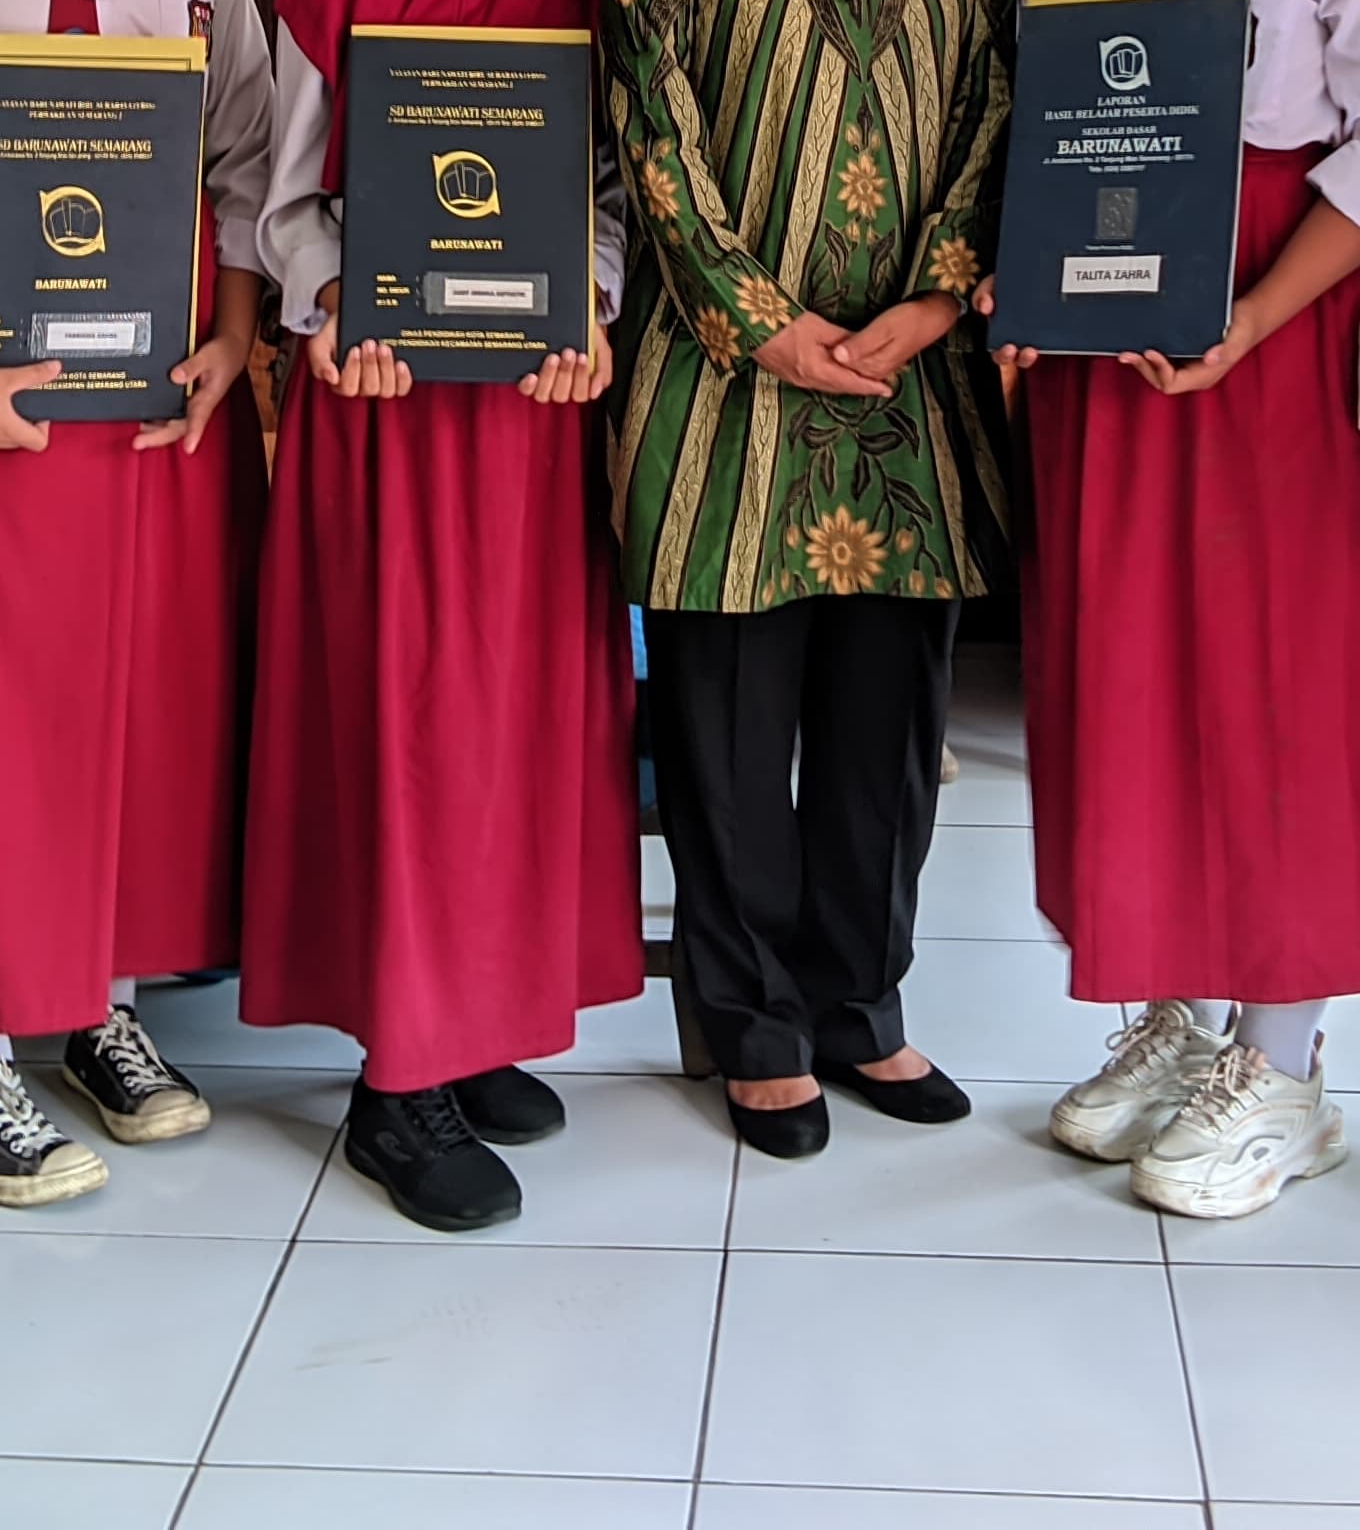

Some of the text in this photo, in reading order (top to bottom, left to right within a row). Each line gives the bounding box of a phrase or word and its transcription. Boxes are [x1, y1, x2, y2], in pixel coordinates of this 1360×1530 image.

[1098, 95, 1146, 106] LAPORAN
[390, 105, 543, 120] SD BARUNAWATI SEMARANG
[1045, 105, 1199, 120] HASIL BELAJAR PESERTA DIDIK
[1082, 126, 1124, 135] SEKOLAH
[14, 139, 87, 152] BARUNAWATI
[90, 139, 151, 152] SEMARANG
[1057, 136, 1182, 154] BARUNAWATI
[430, 239, 503, 250] BARUNAWATI
[1075, 270, 1151, 281] TALITA ZAHRA
[35, 278, 107, 290] BARUNAWATI
